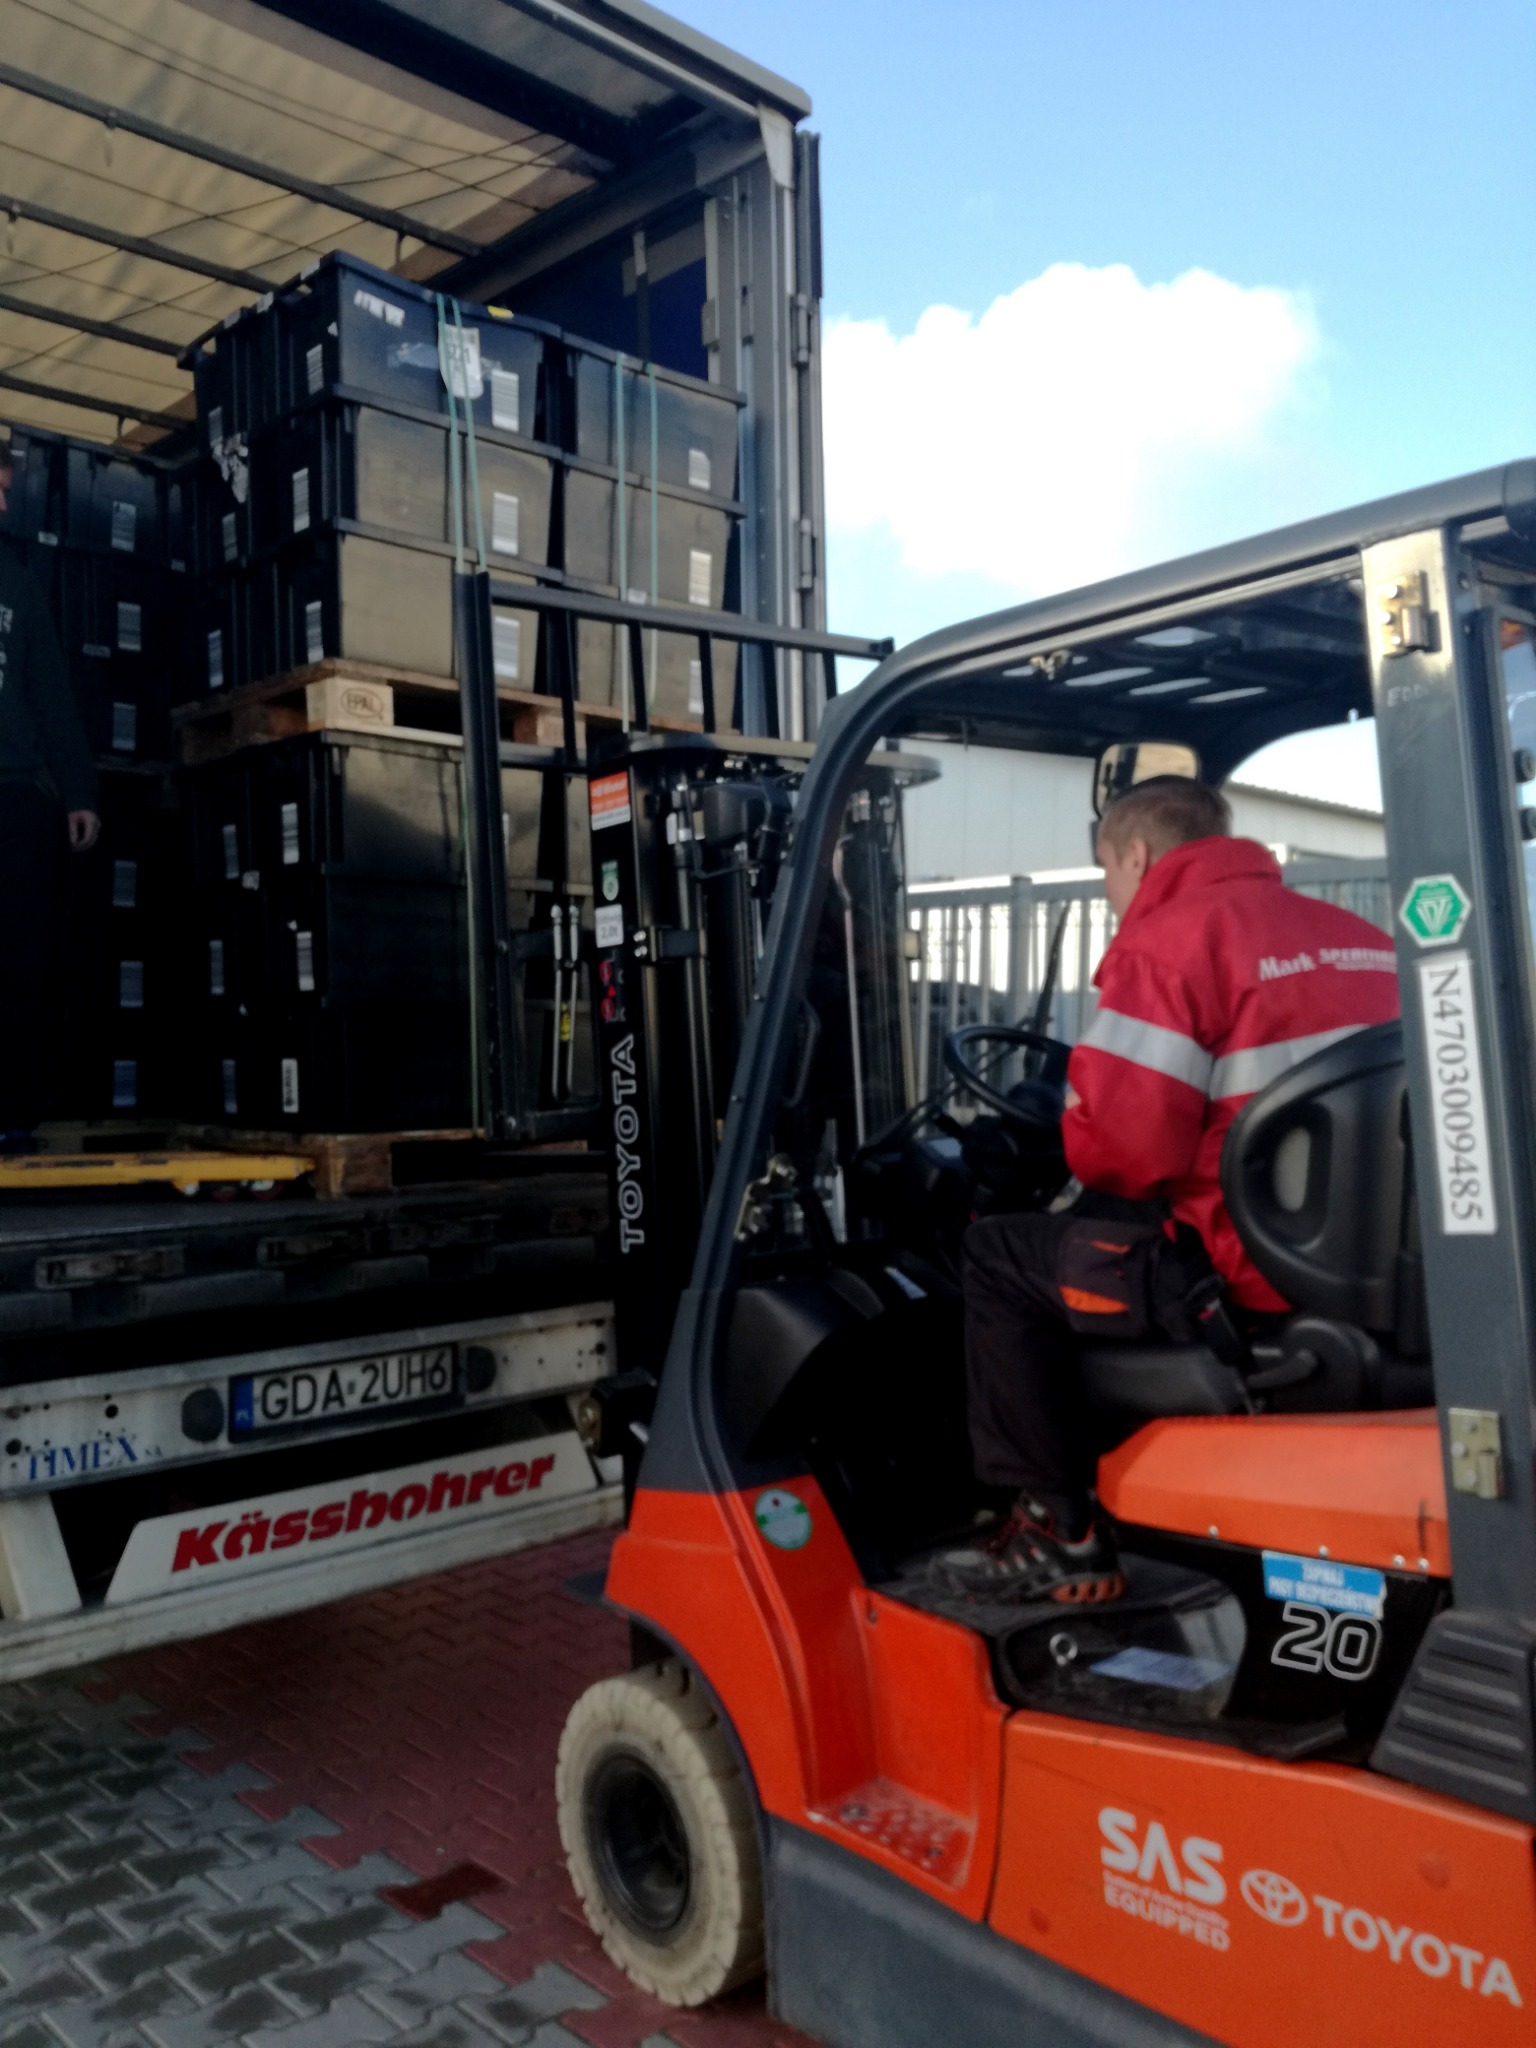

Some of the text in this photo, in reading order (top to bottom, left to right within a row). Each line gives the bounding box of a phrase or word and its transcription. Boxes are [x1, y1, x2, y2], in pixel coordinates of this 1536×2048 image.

[1259, 952, 1317, 981] Mark
[1428, 962, 1484, 1221] N4703009485
[610, 1033, 645, 1254] TOYOTA
[260, 1352, 447, 1420] GDA 2UH6
[23, 1434, 138, 1481] TIMEX
[171, 1453, 556, 1573] Kässbohrer
[1270, 1600, 1382, 1681] 20
[1098, 1807, 1227, 1905] SAS
[1103, 1884, 1231, 1951] EQUIPPED
[1312, 1894, 1524, 2008] TOYOTA
